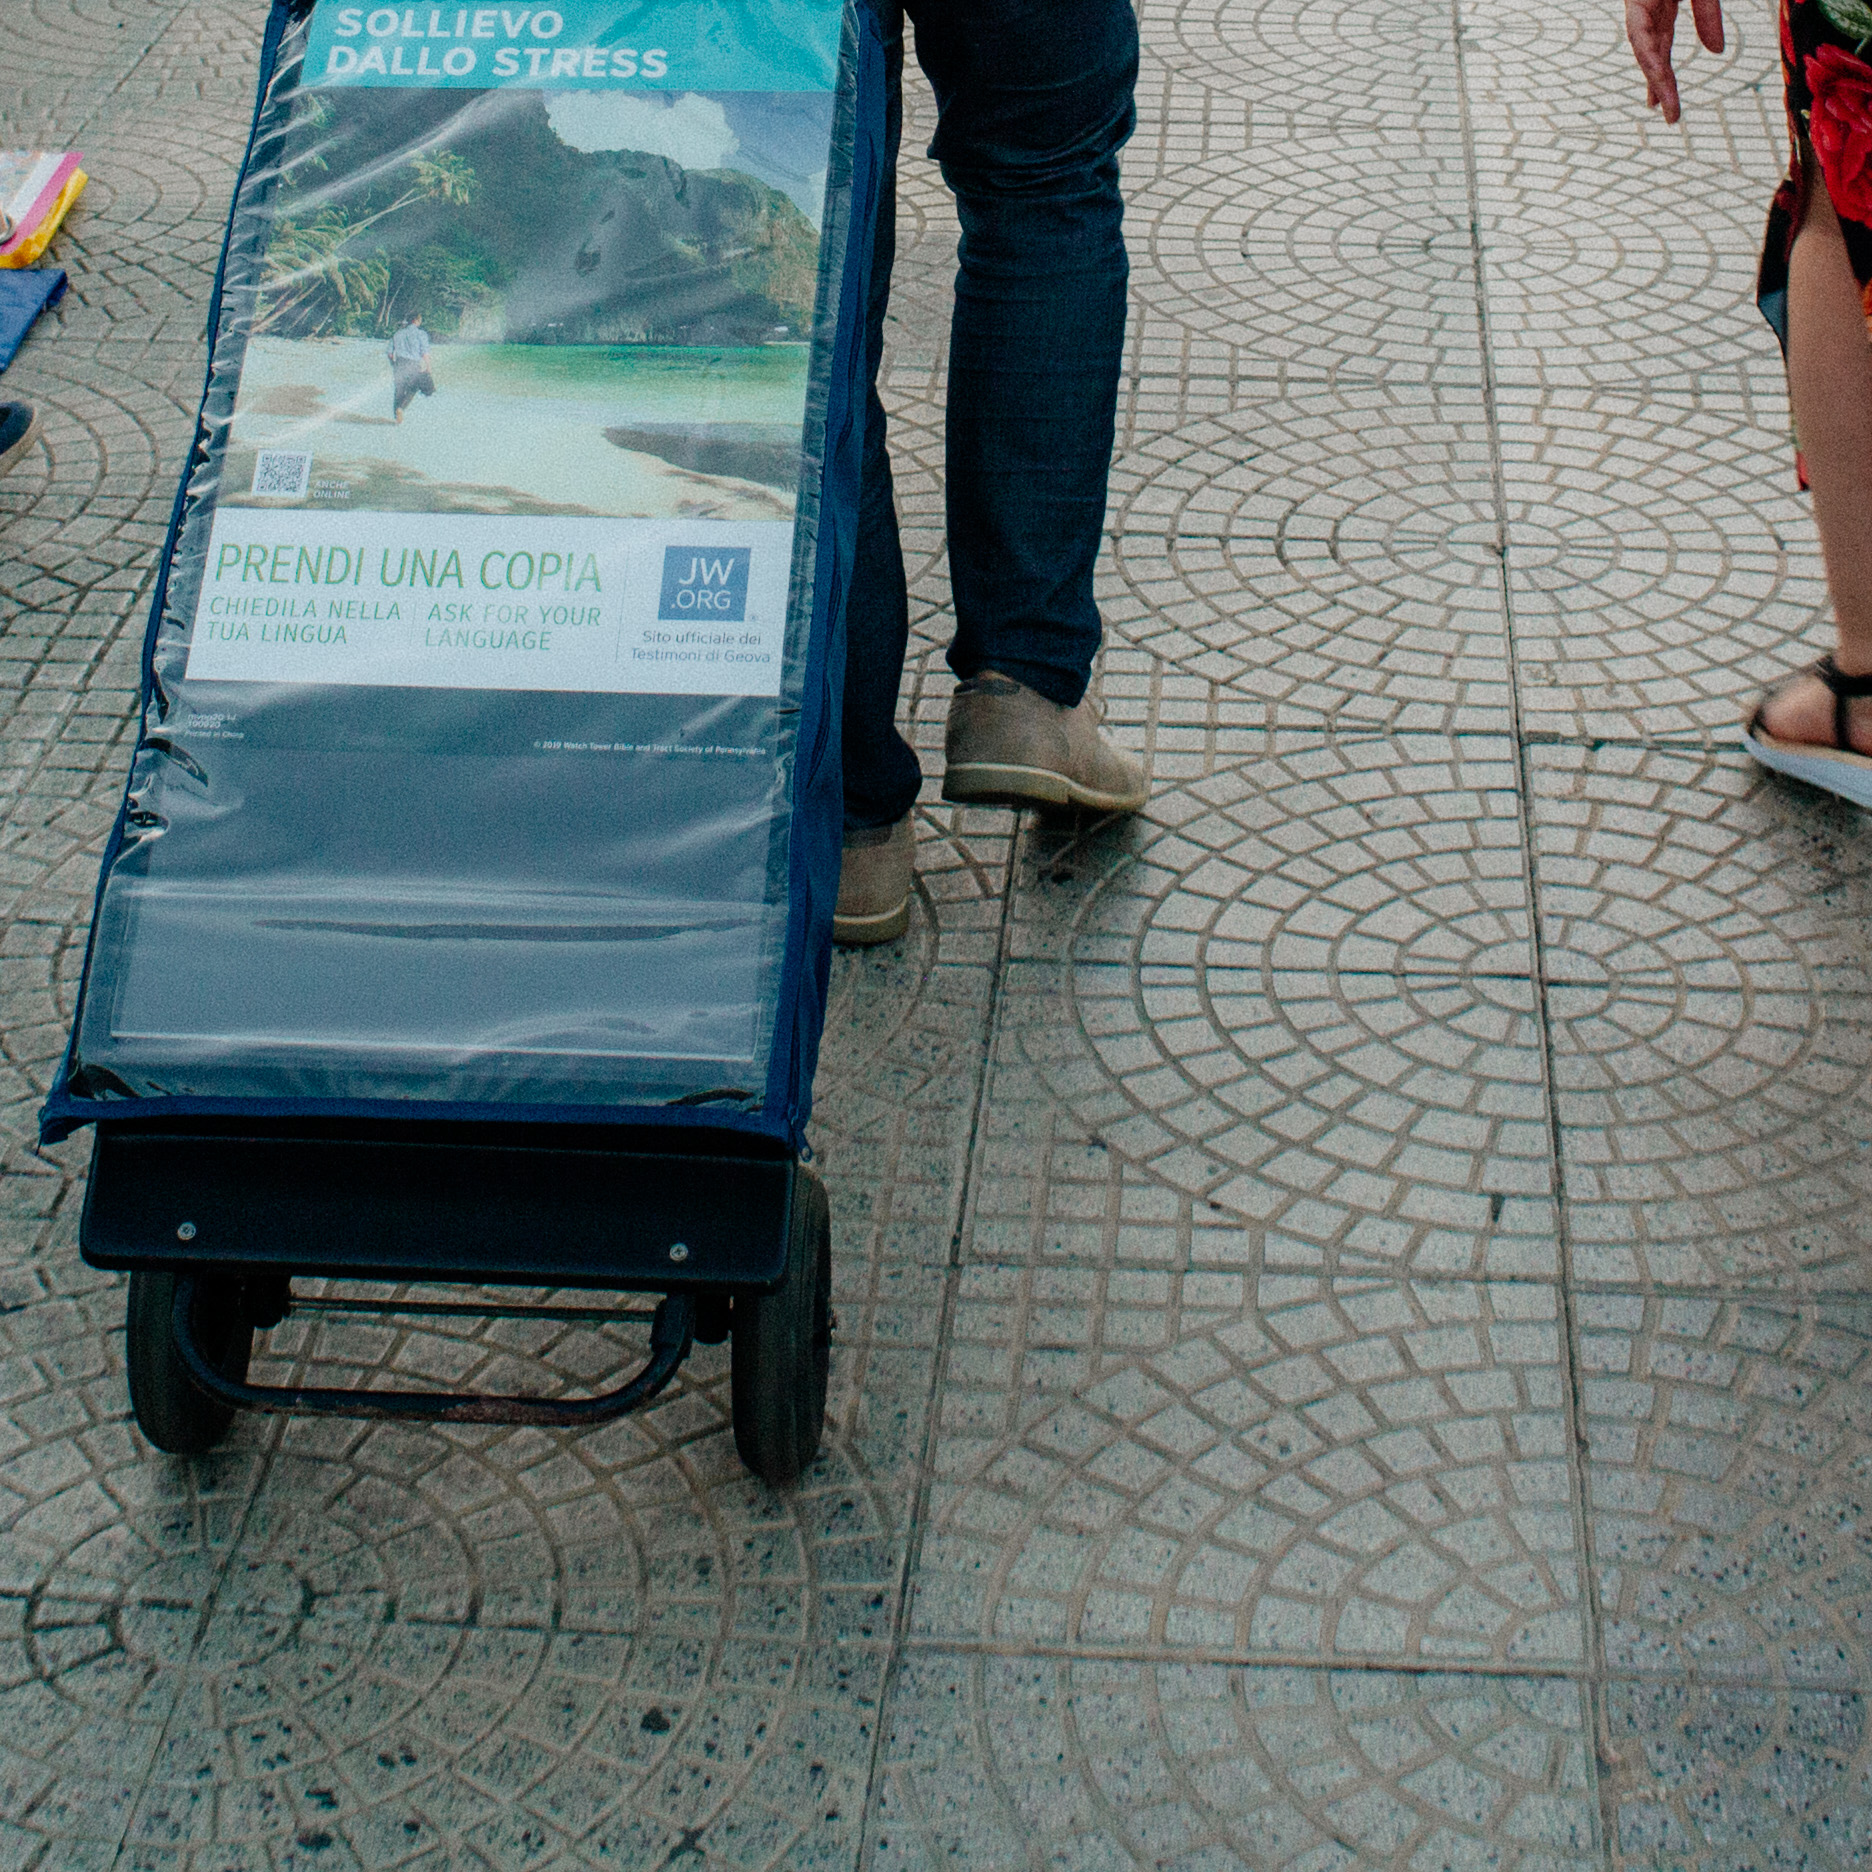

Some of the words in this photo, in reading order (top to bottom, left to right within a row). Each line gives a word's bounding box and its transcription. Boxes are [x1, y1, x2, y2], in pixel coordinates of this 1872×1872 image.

[335, 8, 564, 39] SOLLIEVO
[329, 45, 477, 76] DALLO
[492, 46, 669, 79] STRESS
[313, 490, 350, 499] ONLINE
[314, 480, 350, 489] ANCHE
[215, 543, 365, 585] PRENDI
[380, 548, 464, 589] UNA
[480, 550, 601, 592] COPIA
[679, 557, 735, 585] JW
[209, 596, 317, 618] CHIEDILA
[328, 600, 401, 620] NELLA
[671, 589, 731, 610] .ORG
[427, 603, 473, 622] ASK
[483, 604, 528, 624] FOR
[539, 605, 601, 626] YOUR
[208, 621, 250, 641] TUA
[261, 624, 347, 644] LINGUA
[425, 628, 553, 651] LANGUAGE
[642, 630, 671, 643] Sito
[675, 631, 735, 645] ufficiale
[739, 632, 761, 645] dei
[632, 648, 701, 662] Testimoni
[705, 649, 720, 662] di
[724, 650, 771, 664] Geova
[563, 741, 588, 750] Watch
[589, 742, 612, 751] Tower
[635, 744, 651, 752] and
